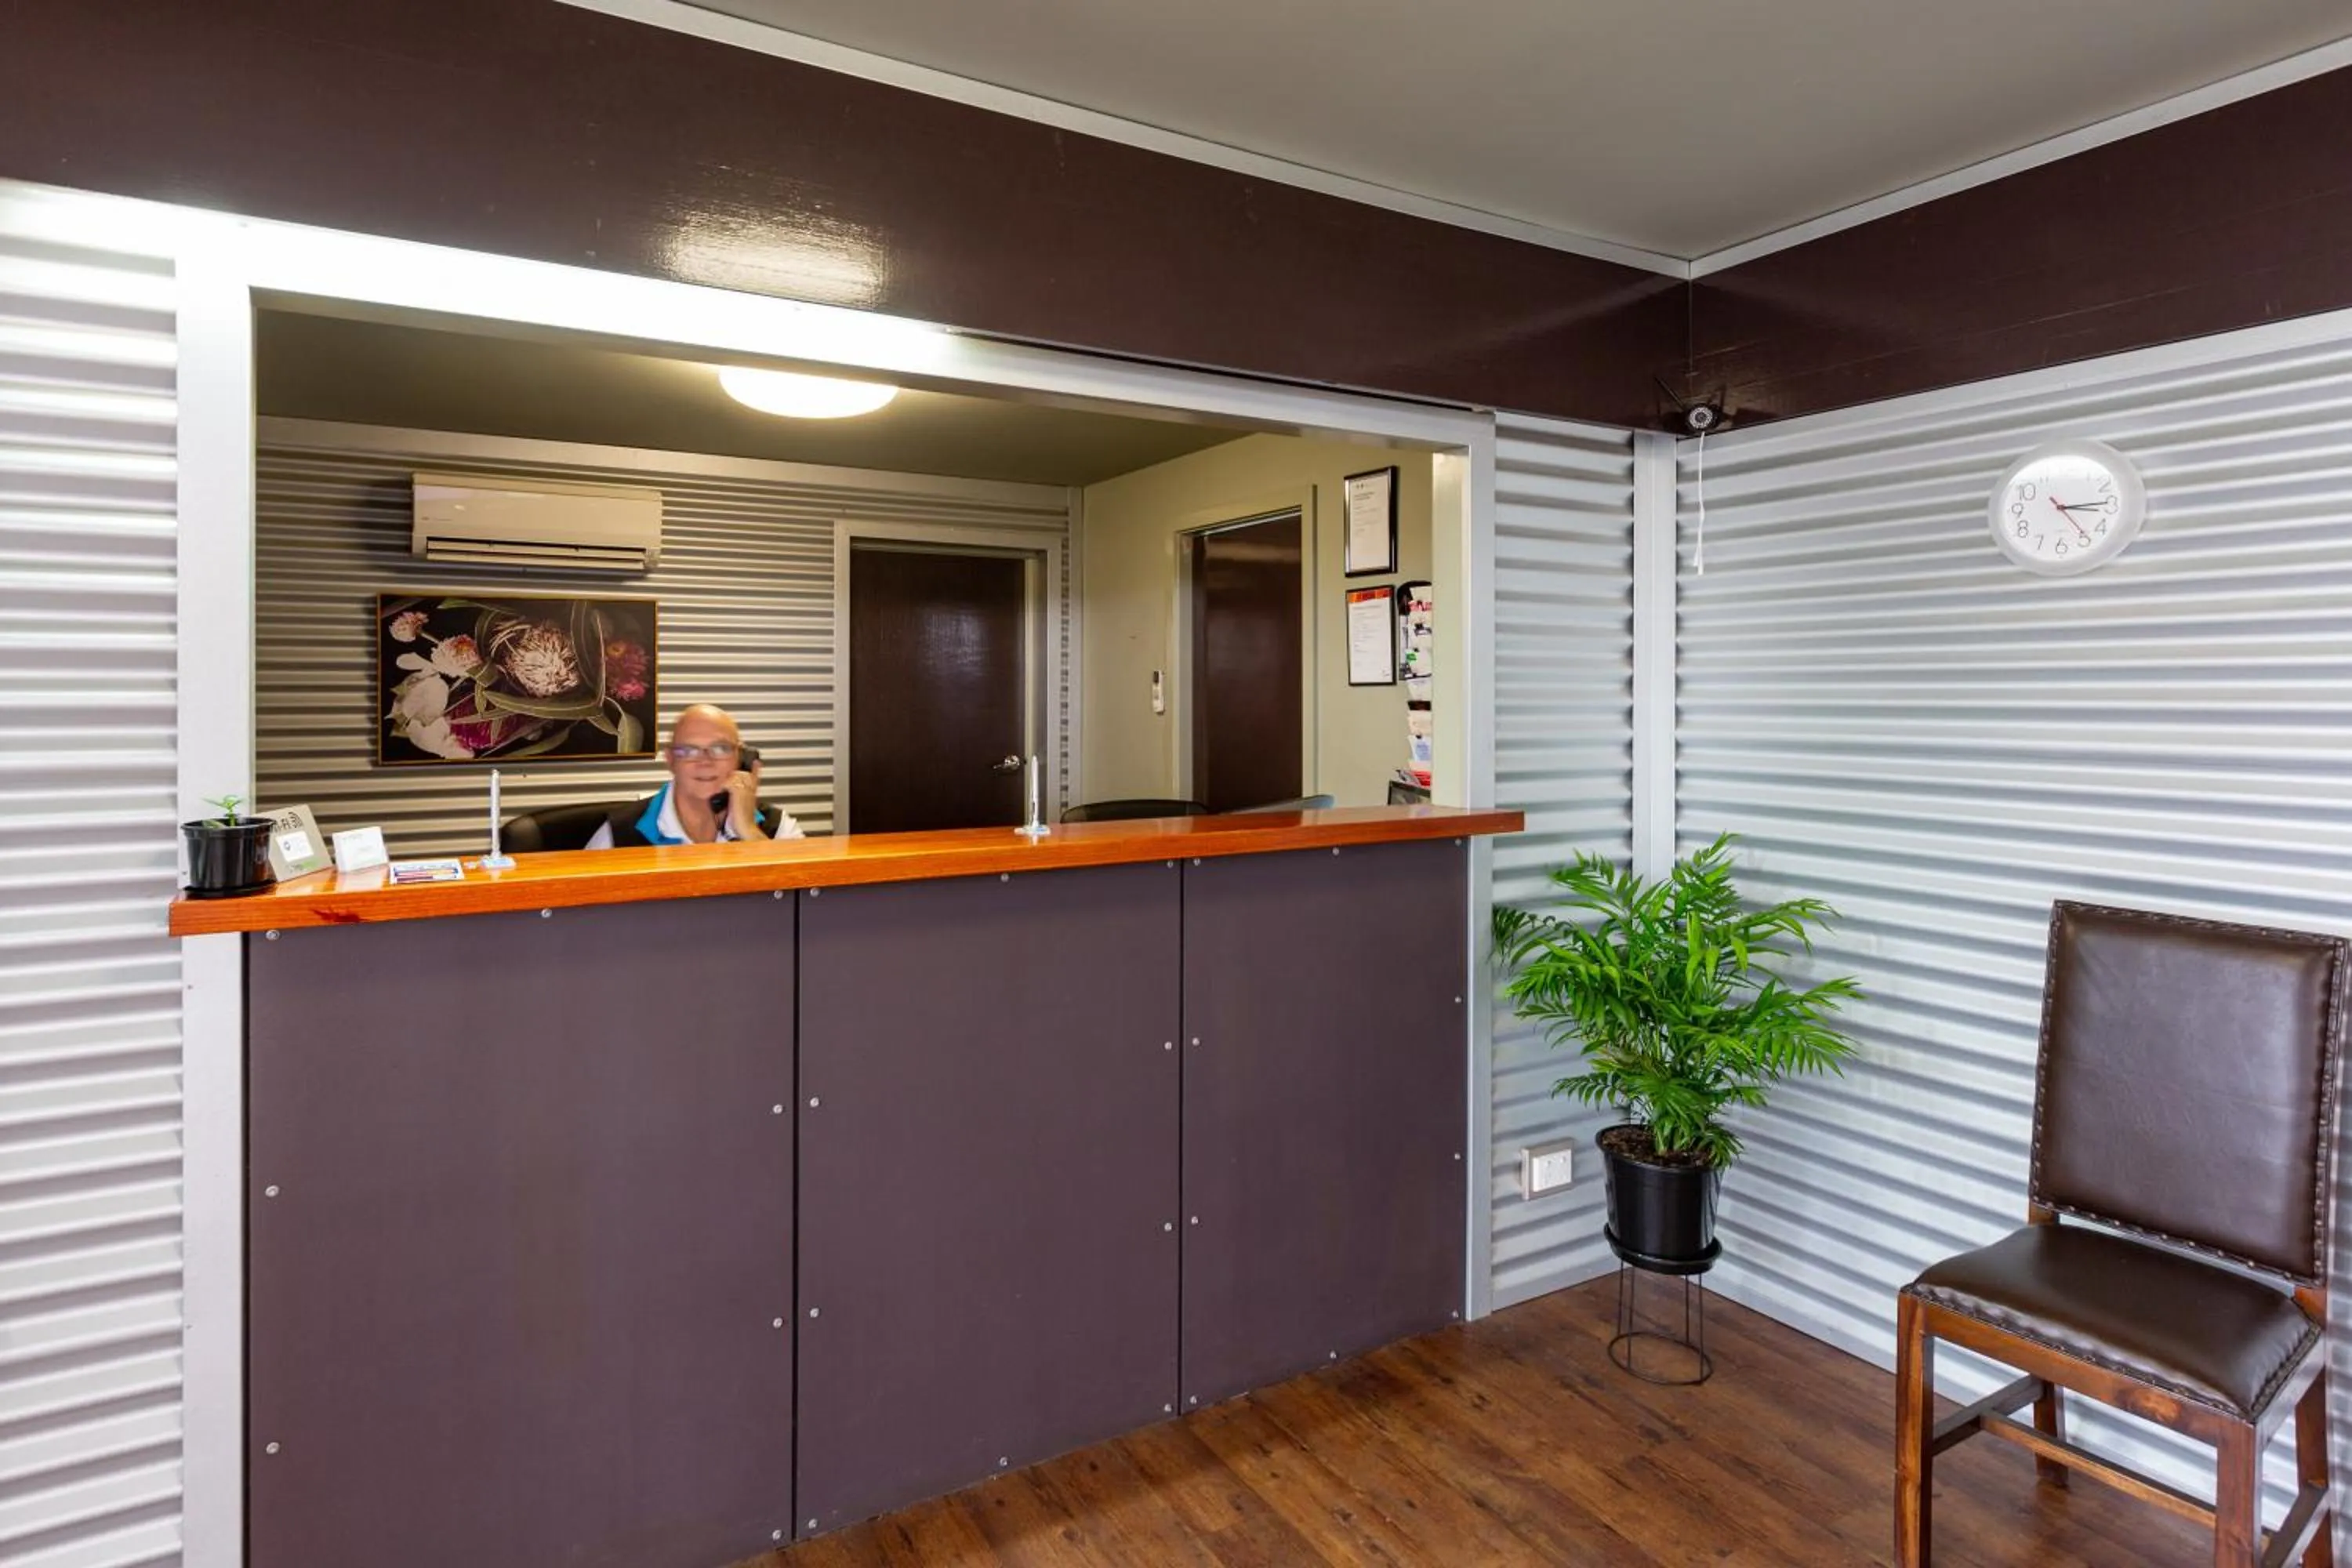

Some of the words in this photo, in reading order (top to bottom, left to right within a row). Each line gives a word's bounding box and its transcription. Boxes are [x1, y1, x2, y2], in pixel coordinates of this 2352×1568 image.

[2017, 482, 2037, 501] 10
[2097, 475, 2112, 493] 2
[2011, 502, 2024, 517] 9
[2104, 495, 2118, 514] 3
[2017, 520, 2029, 538] 8
[2094, 517, 2107, 535] 4
[2034, 534, 2044, 550] 7
[2055, 537, 2069, 554] 6
[2078, 531, 2092, 547] 5
